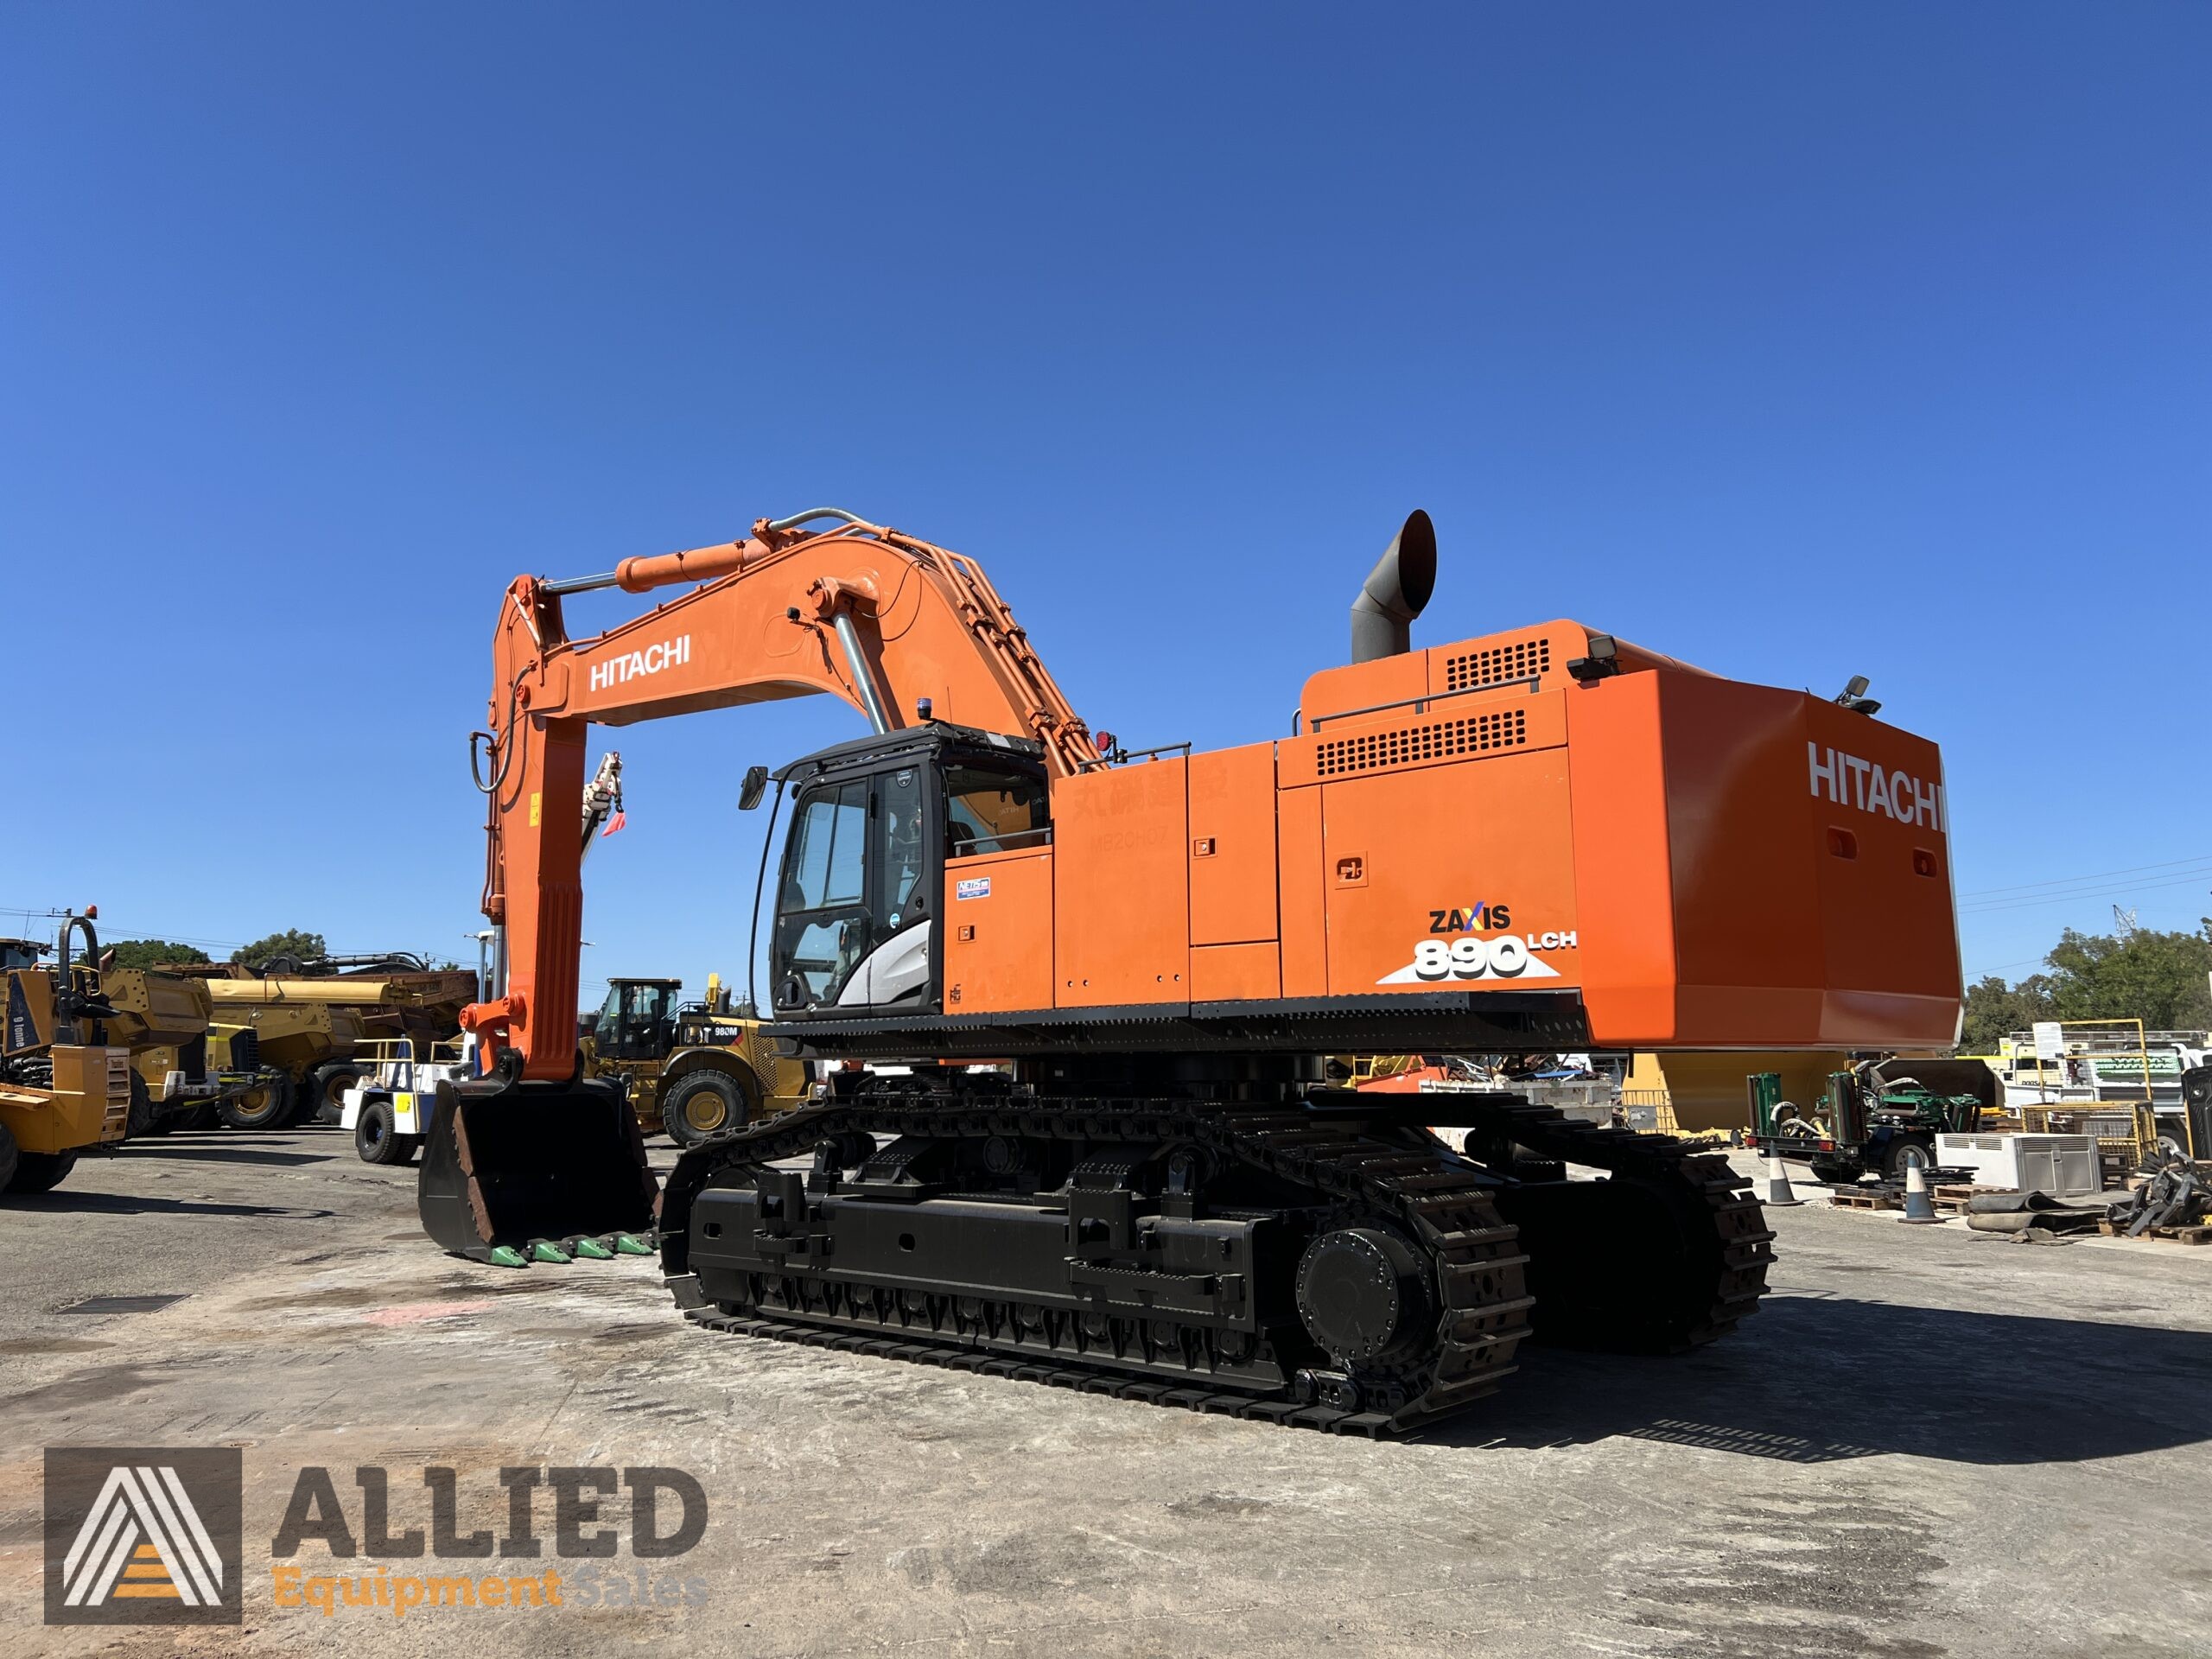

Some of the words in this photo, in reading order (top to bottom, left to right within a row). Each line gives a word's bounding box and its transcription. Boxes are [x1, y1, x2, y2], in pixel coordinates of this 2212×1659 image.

[590, 633, 690, 692] HITACHI
[1808, 741, 1946, 834] HITACHI
[1429, 901, 1511, 933] ZAXIS
[1414, 935, 1528, 981] 890
[1527, 931, 1577, 951] LCH
[14, 1024, 25, 1047] tonne
[715, 1027, 738, 1036] 980M
